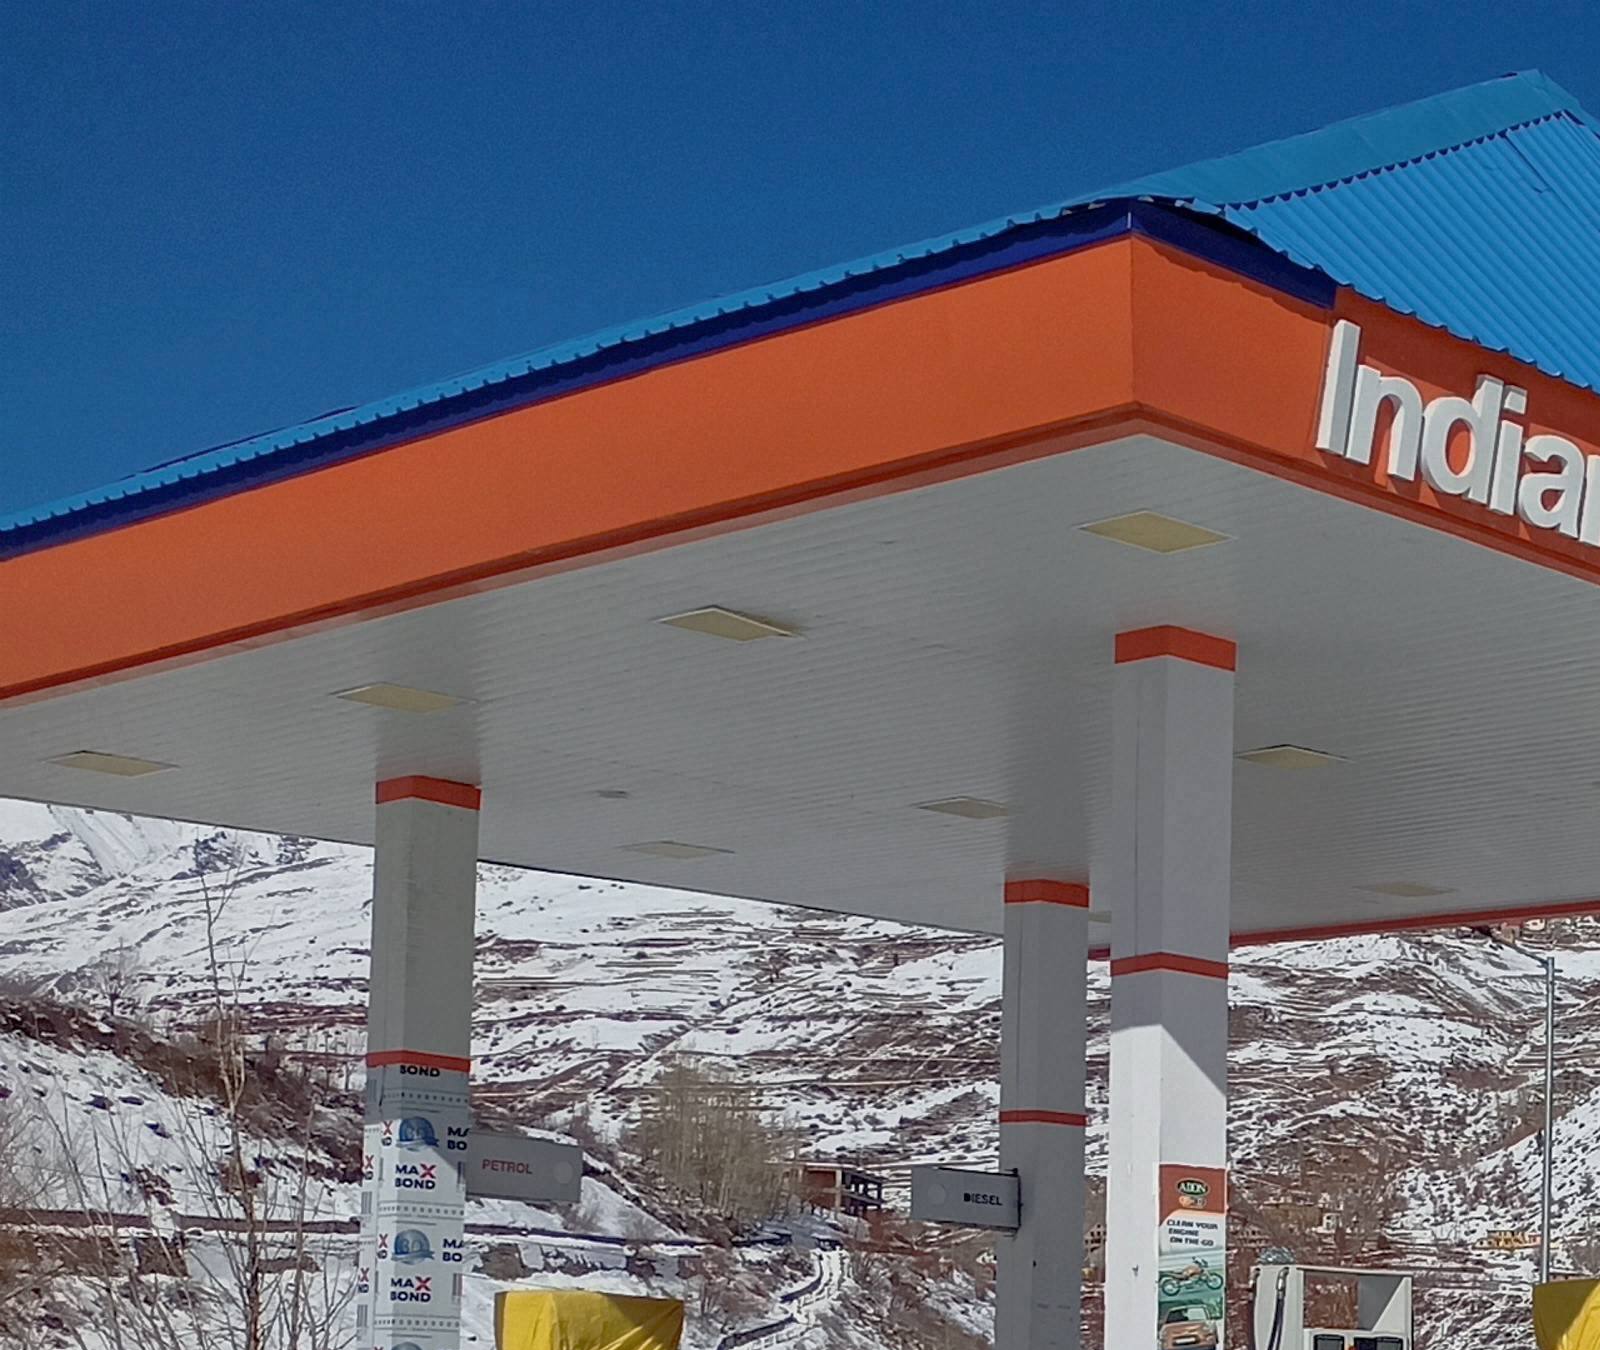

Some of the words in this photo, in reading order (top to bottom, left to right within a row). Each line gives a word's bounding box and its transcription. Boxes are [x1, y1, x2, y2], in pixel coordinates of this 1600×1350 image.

[396, 1164, 436, 1179] MAX
[482, 1159, 533, 1175] PETROL
[395, 1179, 436, 1190] BOND
[963, 1193, 1003, 1206] DIESEL
[1167, 1219, 1194, 1227] CLEAN
[1196, 1222, 1218, 1230] YOUR
[1168, 1228, 1199, 1236] ENGINE
[391, 1276, 432, 1292] MAX
[390, 1291, 431, 1302] BOND
